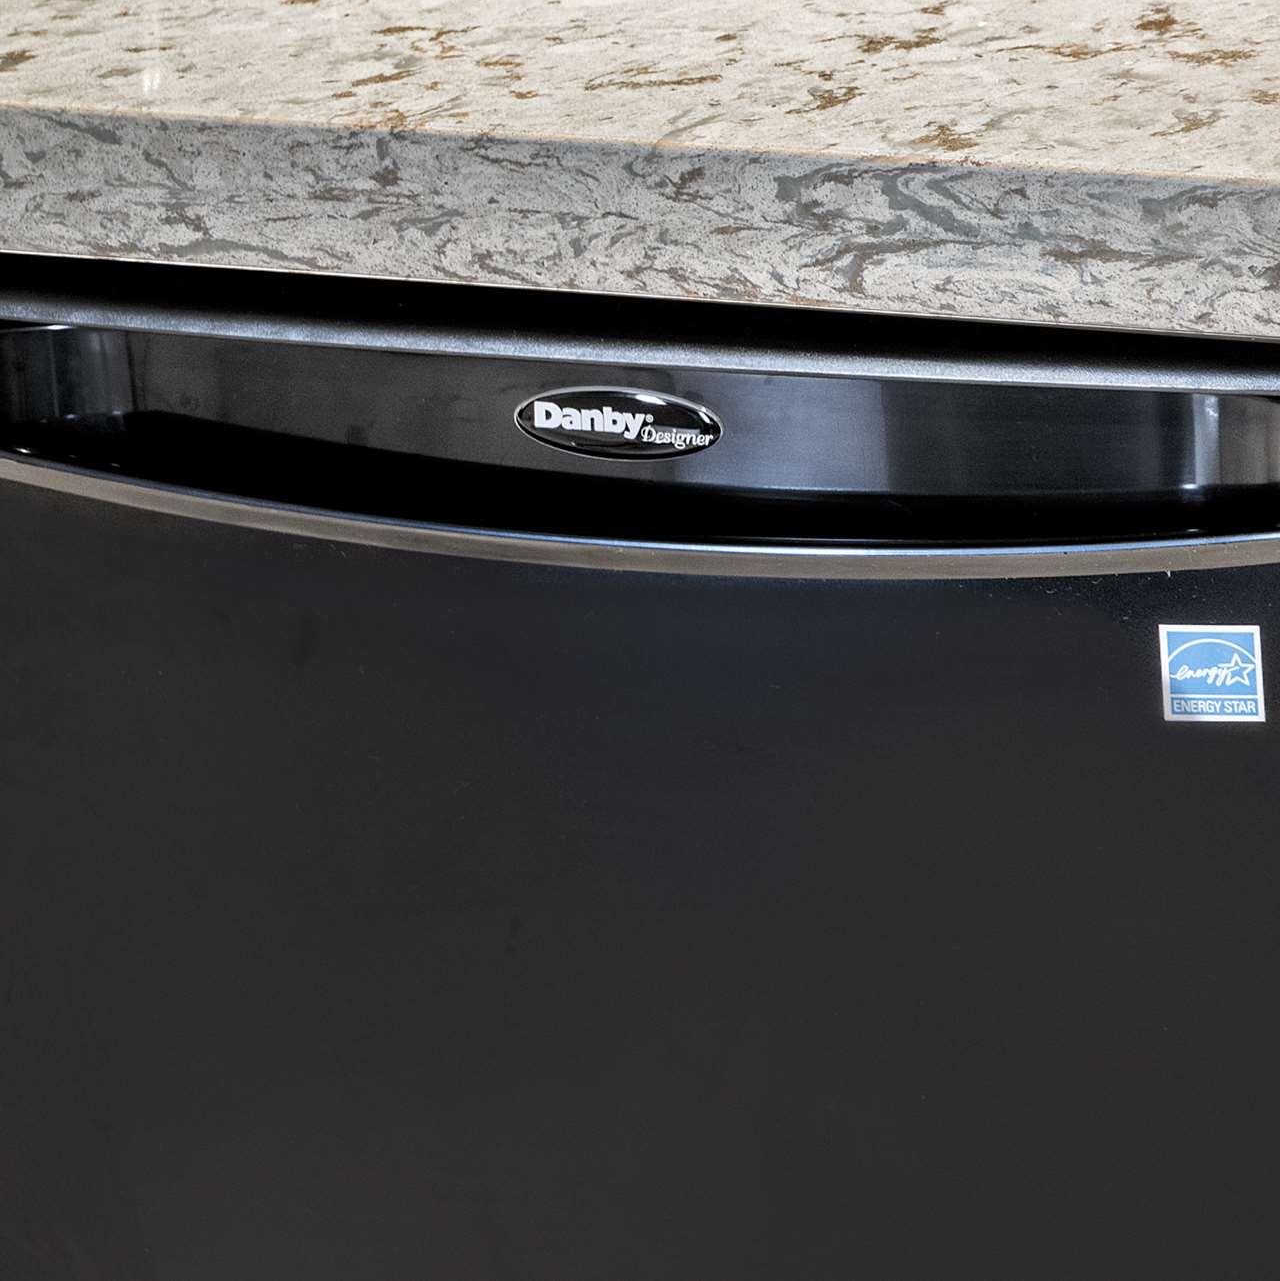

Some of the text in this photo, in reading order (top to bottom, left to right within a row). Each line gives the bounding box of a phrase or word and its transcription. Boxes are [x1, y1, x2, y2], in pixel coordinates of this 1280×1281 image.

[534, 400, 713, 449] Danby Designer
[1173, 699, 1256, 713] ENERGY STAR
